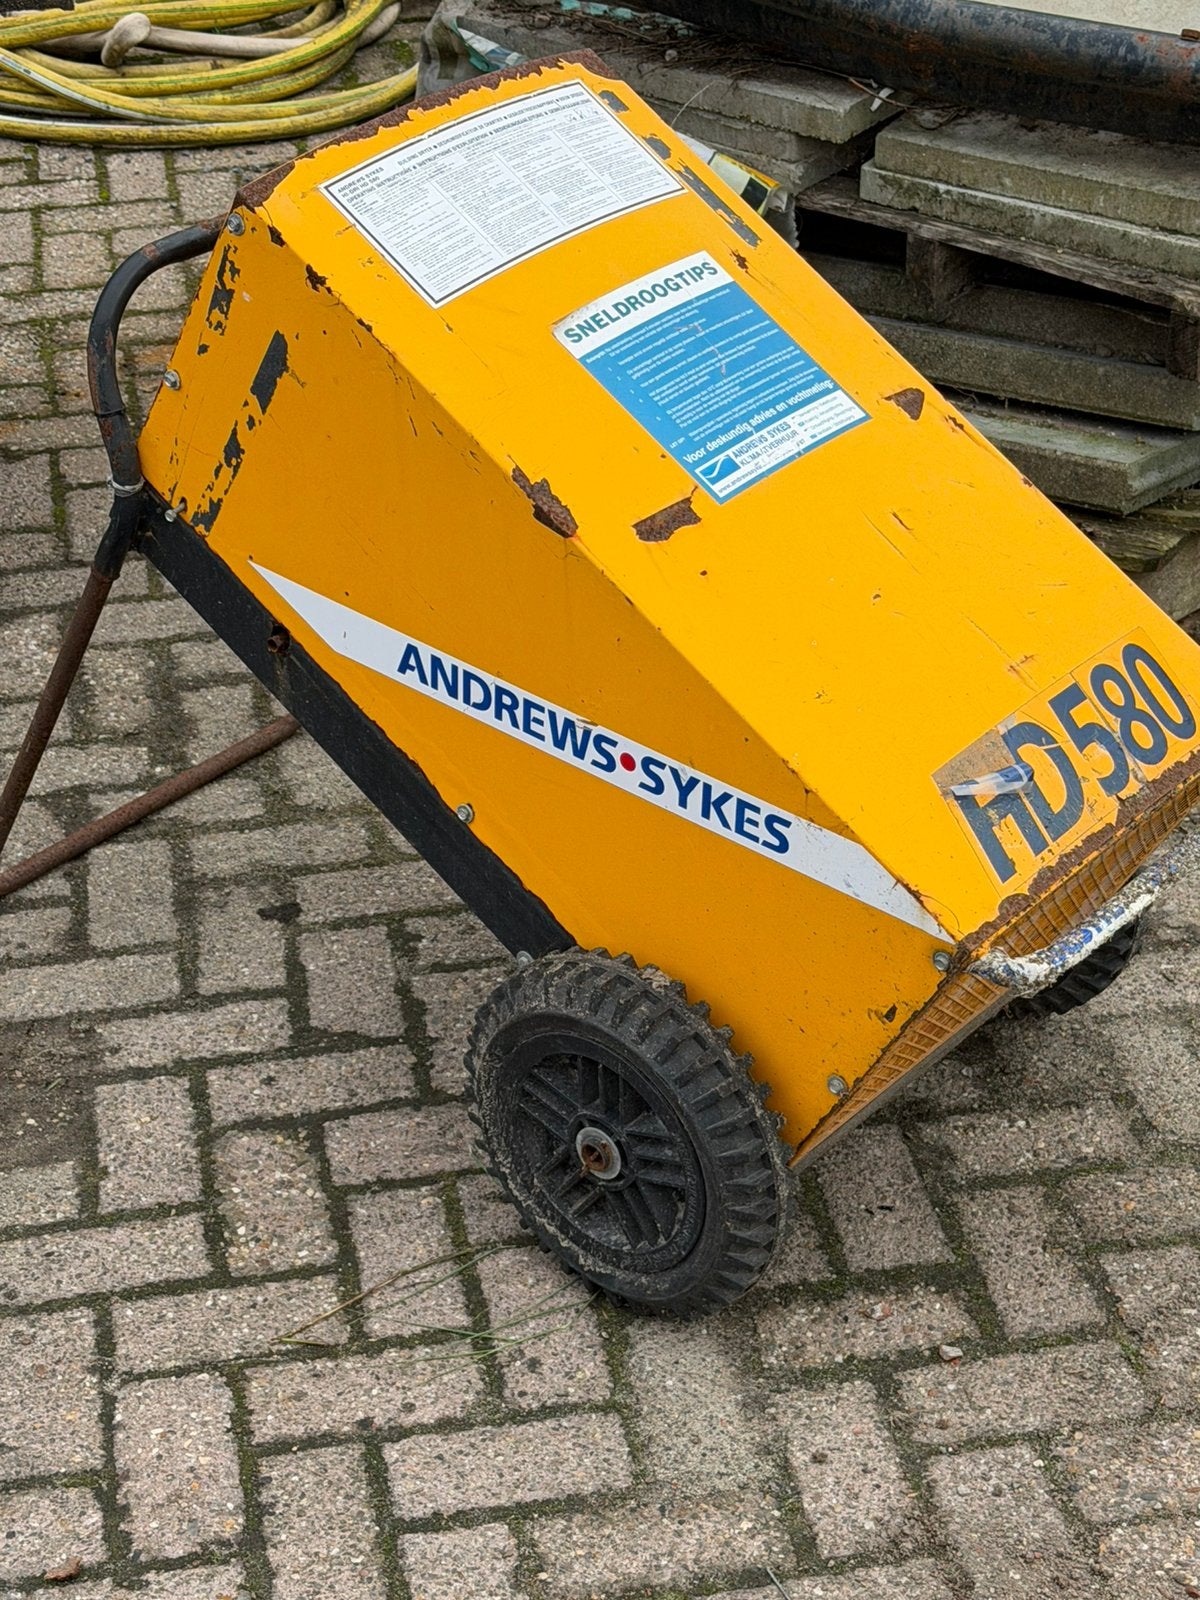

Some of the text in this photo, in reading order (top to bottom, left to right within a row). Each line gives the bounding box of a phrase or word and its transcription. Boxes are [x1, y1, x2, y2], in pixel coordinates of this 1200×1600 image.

[337, 166, 384, 193] ANDREWS SYKES
[347, 186, 376, 204] OPERATING
[377, 168, 413, 189] INSTRUCTIONS
[418, 149, 453, 168] INSTRUCTIONS
[563, 260, 719, 345] SNELDROOGTIPS
[683, 448, 706, 464] Voor
[706, 421, 751, 451] deskundig
[750, 407, 777, 427] advies
[775, 402, 788, 413] en
[733, 434, 768, 460] ANDREWS
[768, 421, 792, 440] SYKES
[396, 643, 791, 854] ANDREWS SYKES
